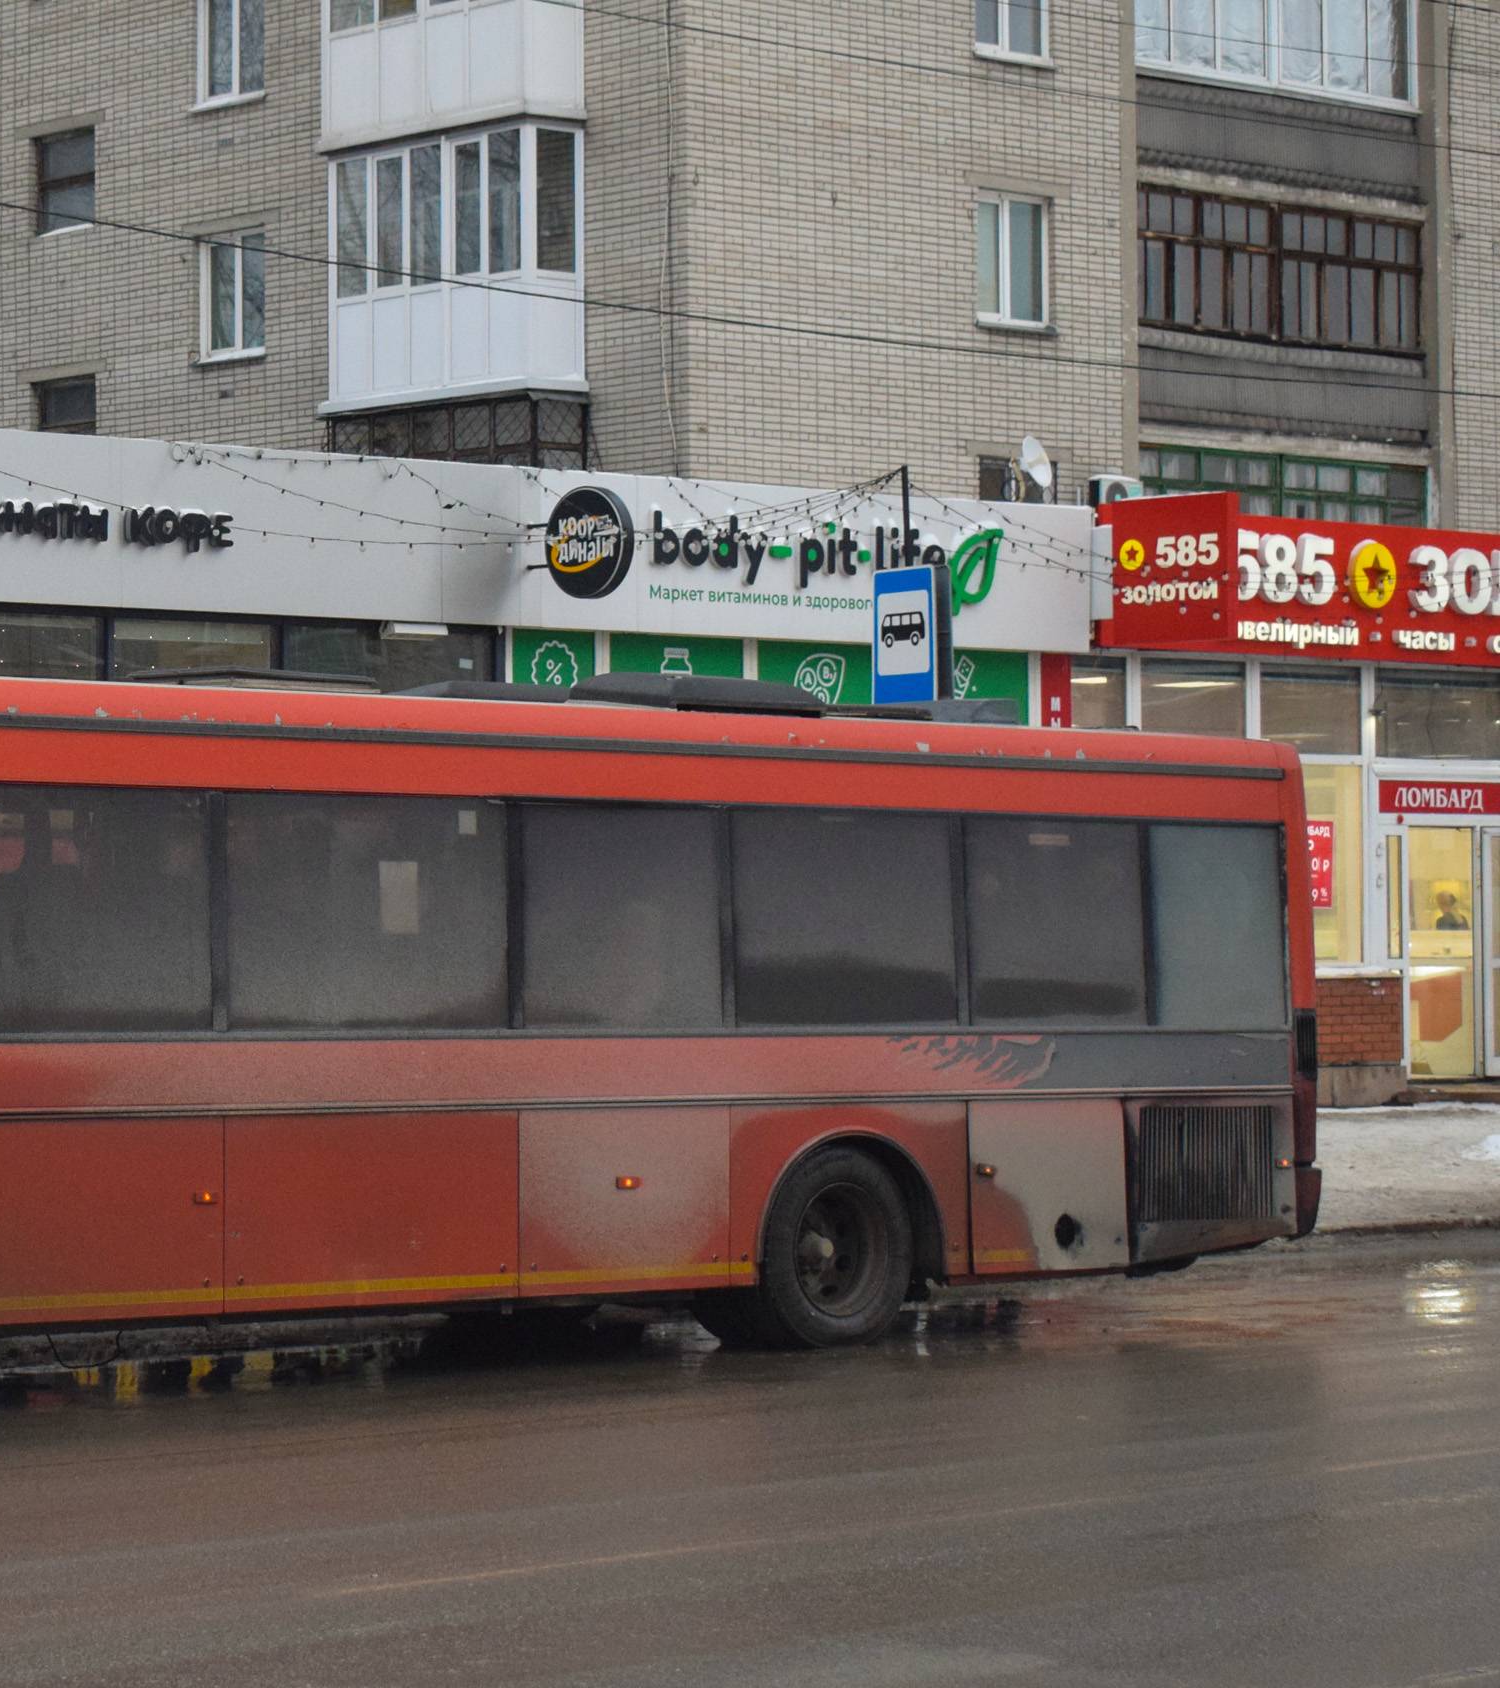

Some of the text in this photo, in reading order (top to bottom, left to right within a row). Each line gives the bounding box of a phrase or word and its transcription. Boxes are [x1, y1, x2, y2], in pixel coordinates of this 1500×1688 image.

[124, 505, 234, 554] КОФЕ
[558, 516, 596, 540] КООР
[1155, 532, 1220, 569] 585
[1238, 528, 1500, 616] 585 ЗО
[649, 584, 874, 614] Маркет витаминов и здоровог
[1394, 628, 1456, 652] часы
[1394, 787, 1485, 813] ЛОМБАРД
